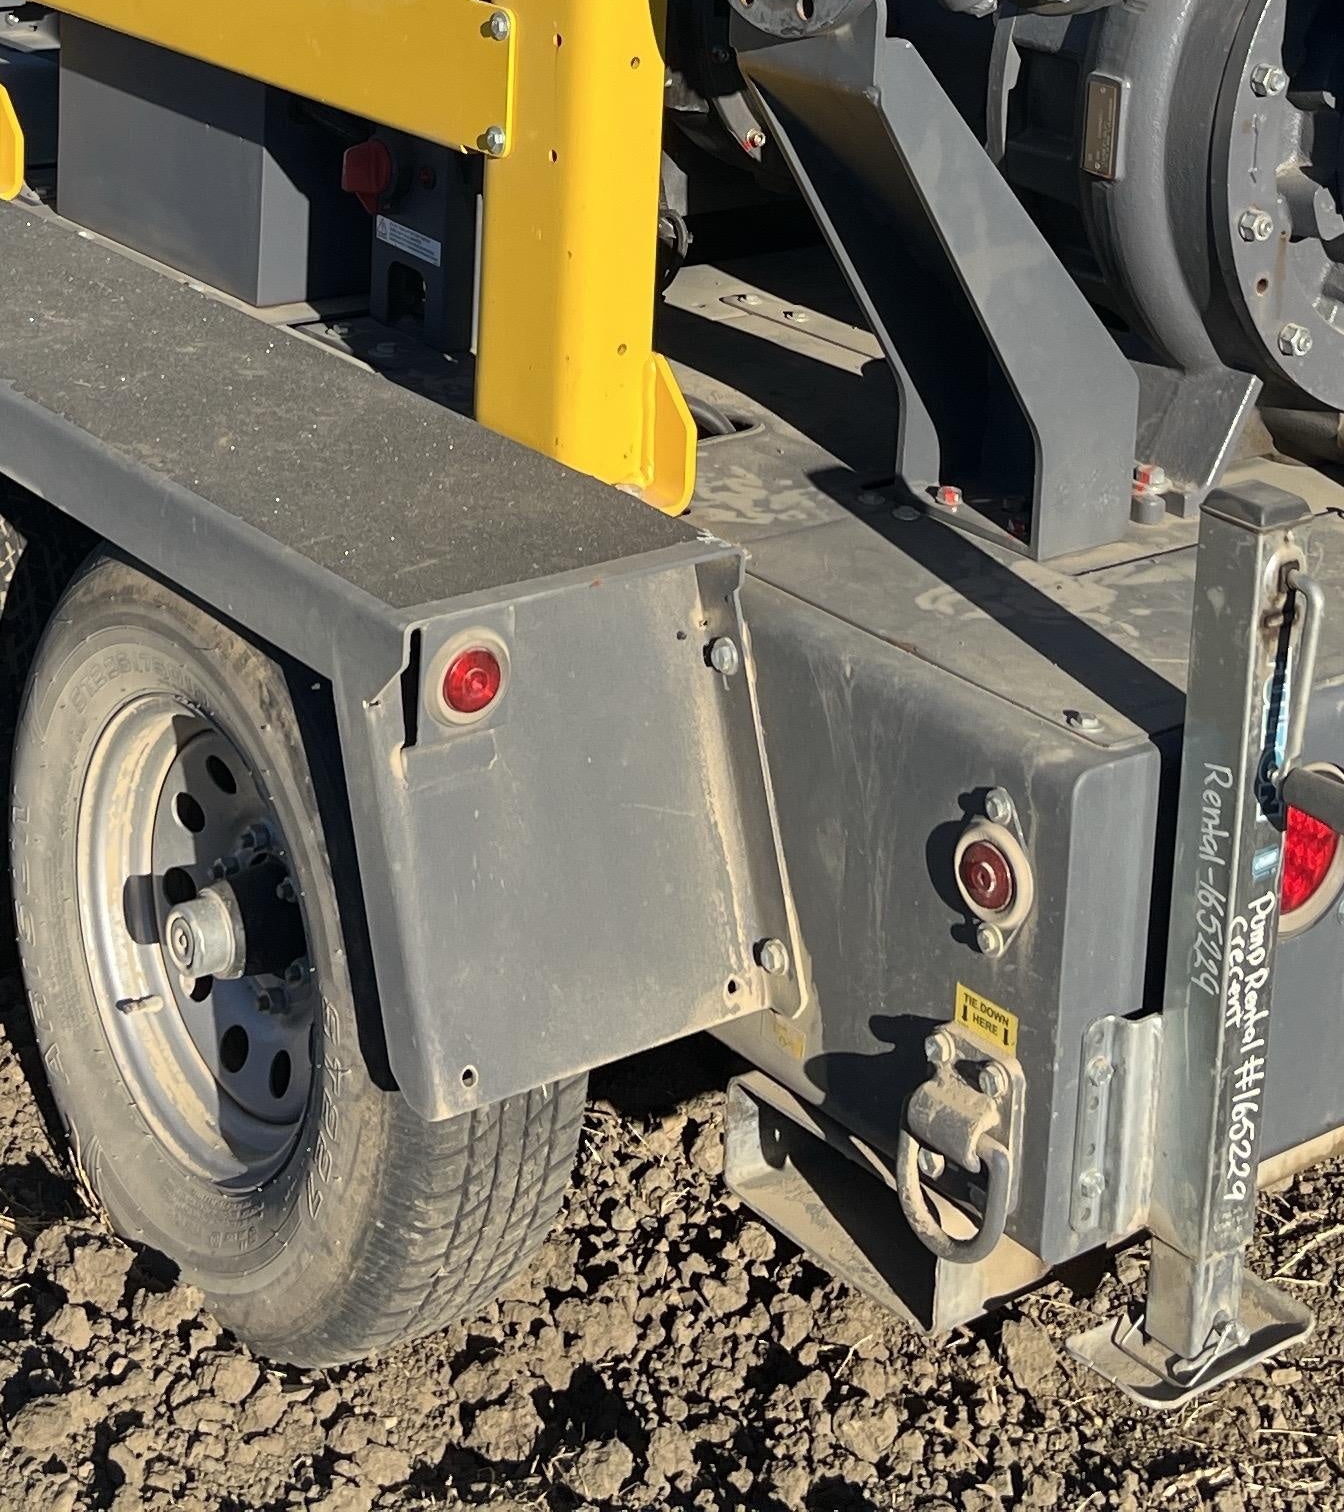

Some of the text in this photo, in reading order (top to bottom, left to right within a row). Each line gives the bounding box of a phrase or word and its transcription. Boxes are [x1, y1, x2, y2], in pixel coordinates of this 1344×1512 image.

[964, 993, 1010, 1027] TIE DOWN
[972, 1012, 998, 1037] HERE
